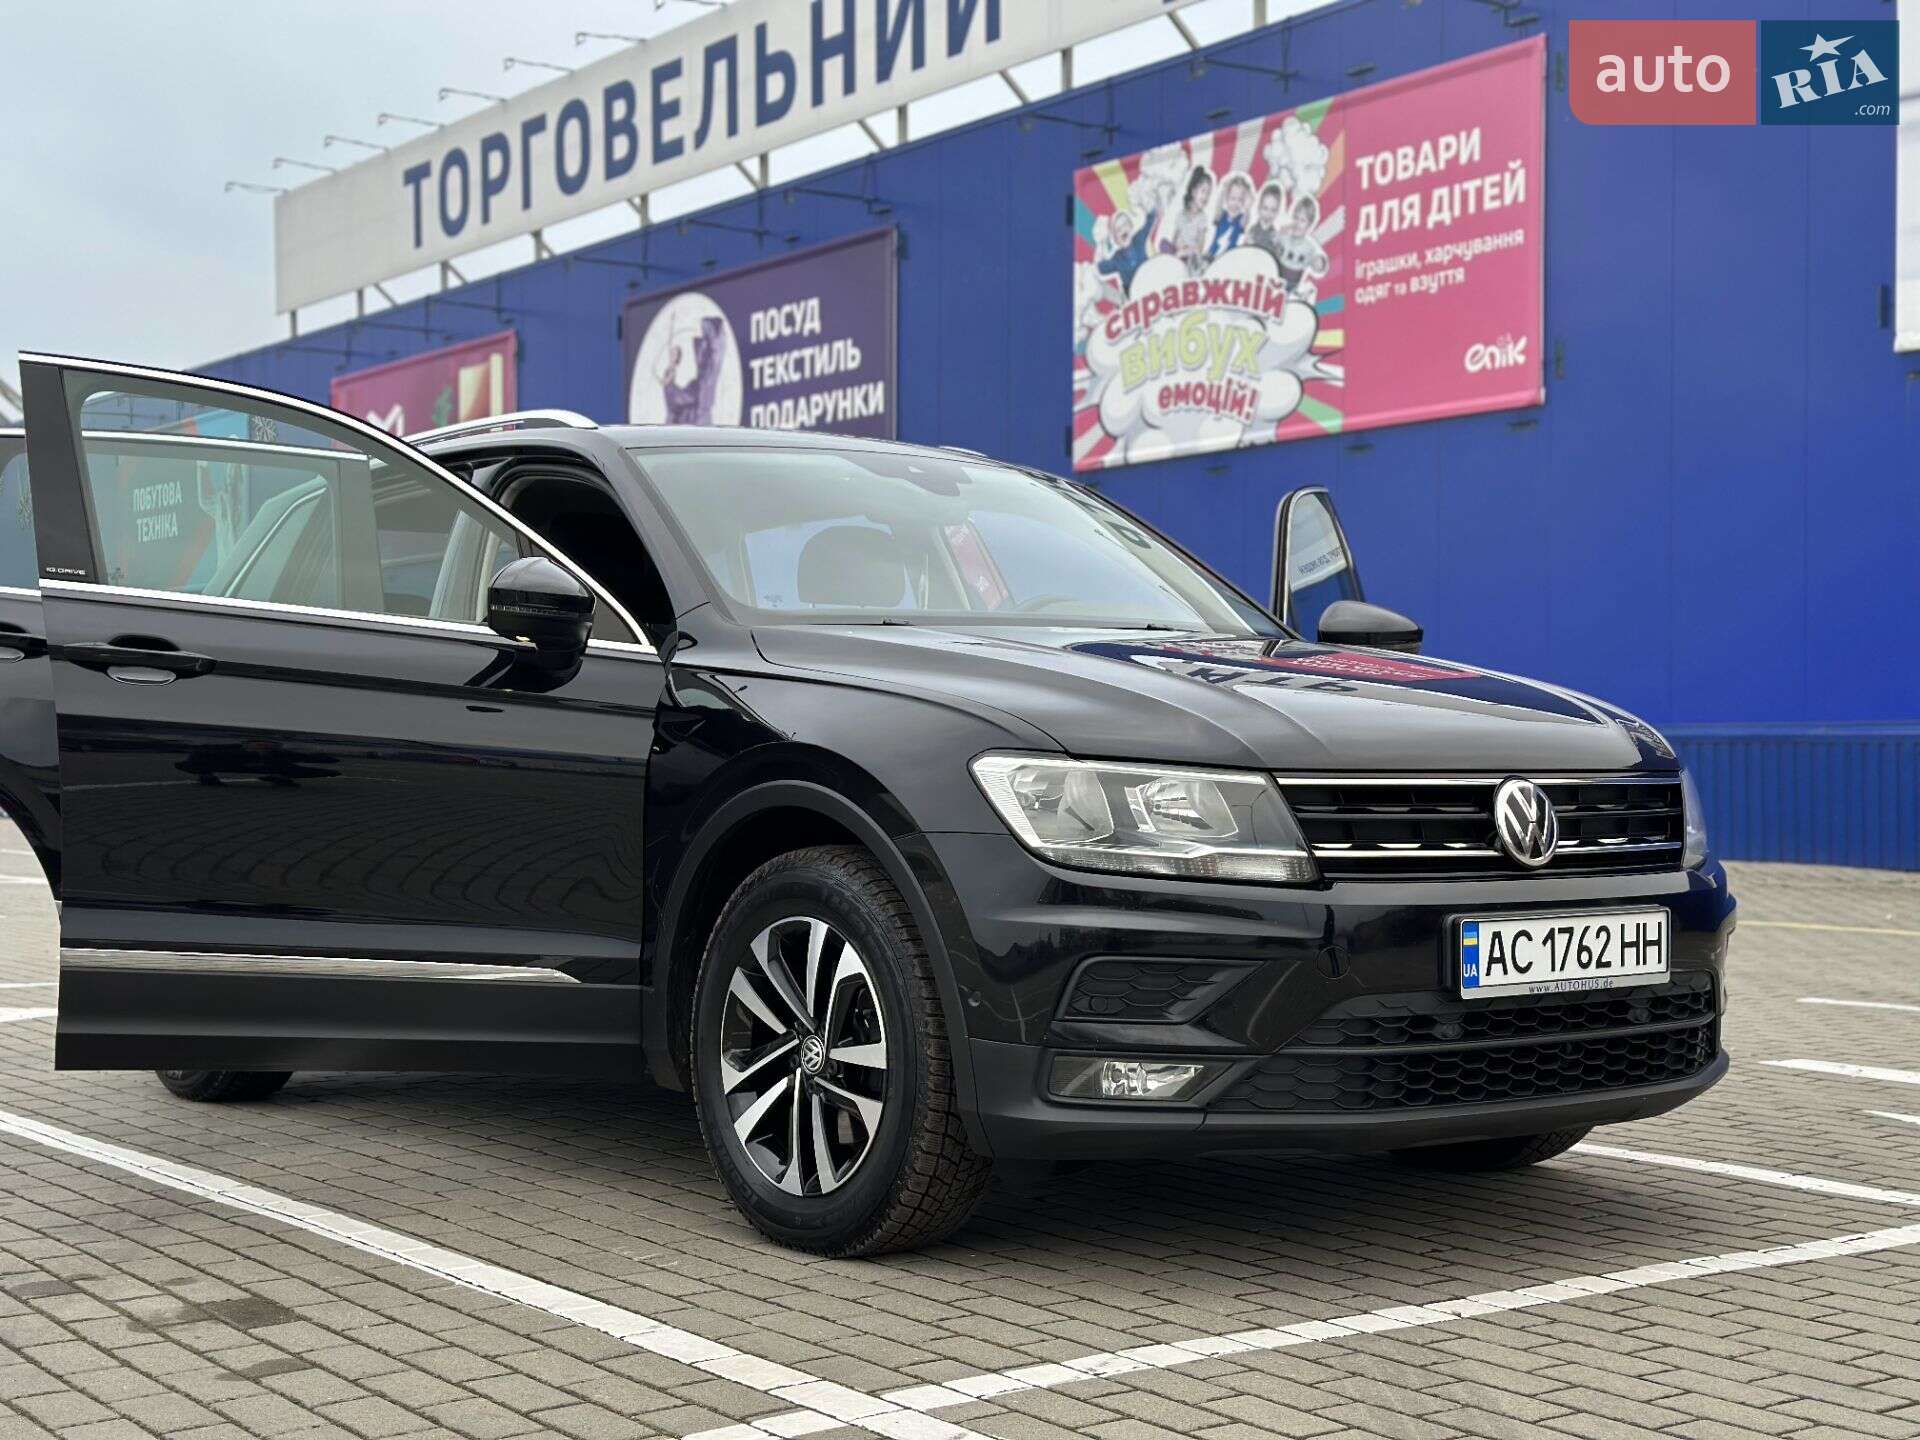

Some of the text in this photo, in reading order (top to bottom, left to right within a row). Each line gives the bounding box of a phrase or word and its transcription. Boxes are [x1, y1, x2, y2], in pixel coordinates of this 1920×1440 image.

[1355, 127, 1480, 190] ТОВАРИ
[1355, 159, 1525, 245] ДЛЯ ДІТЕЙ
[1425, 229, 1525, 265] харчування
[1105, 275, 1286, 340] справжній
[1355, 282, 1392, 305] одяг
[1410, 267, 1465, 294] взуття
[750, 297, 821, 344] ПОСУД
[750, 338, 862, 390] ТЕКСТИЛЬ
[1119, 310, 1267, 391] вибух
[751, 381, 885, 428] ПОДАРУНКИ
[1158, 378, 1260, 421] емоцій!
[133, 481, 183, 512] ПОБУТОВА
[136, 512, 179, 543] ТЕХНІКА
[1463, 962, 1478, 978] UA
[1485, 921, 1663, 976] AC 1762 HH
